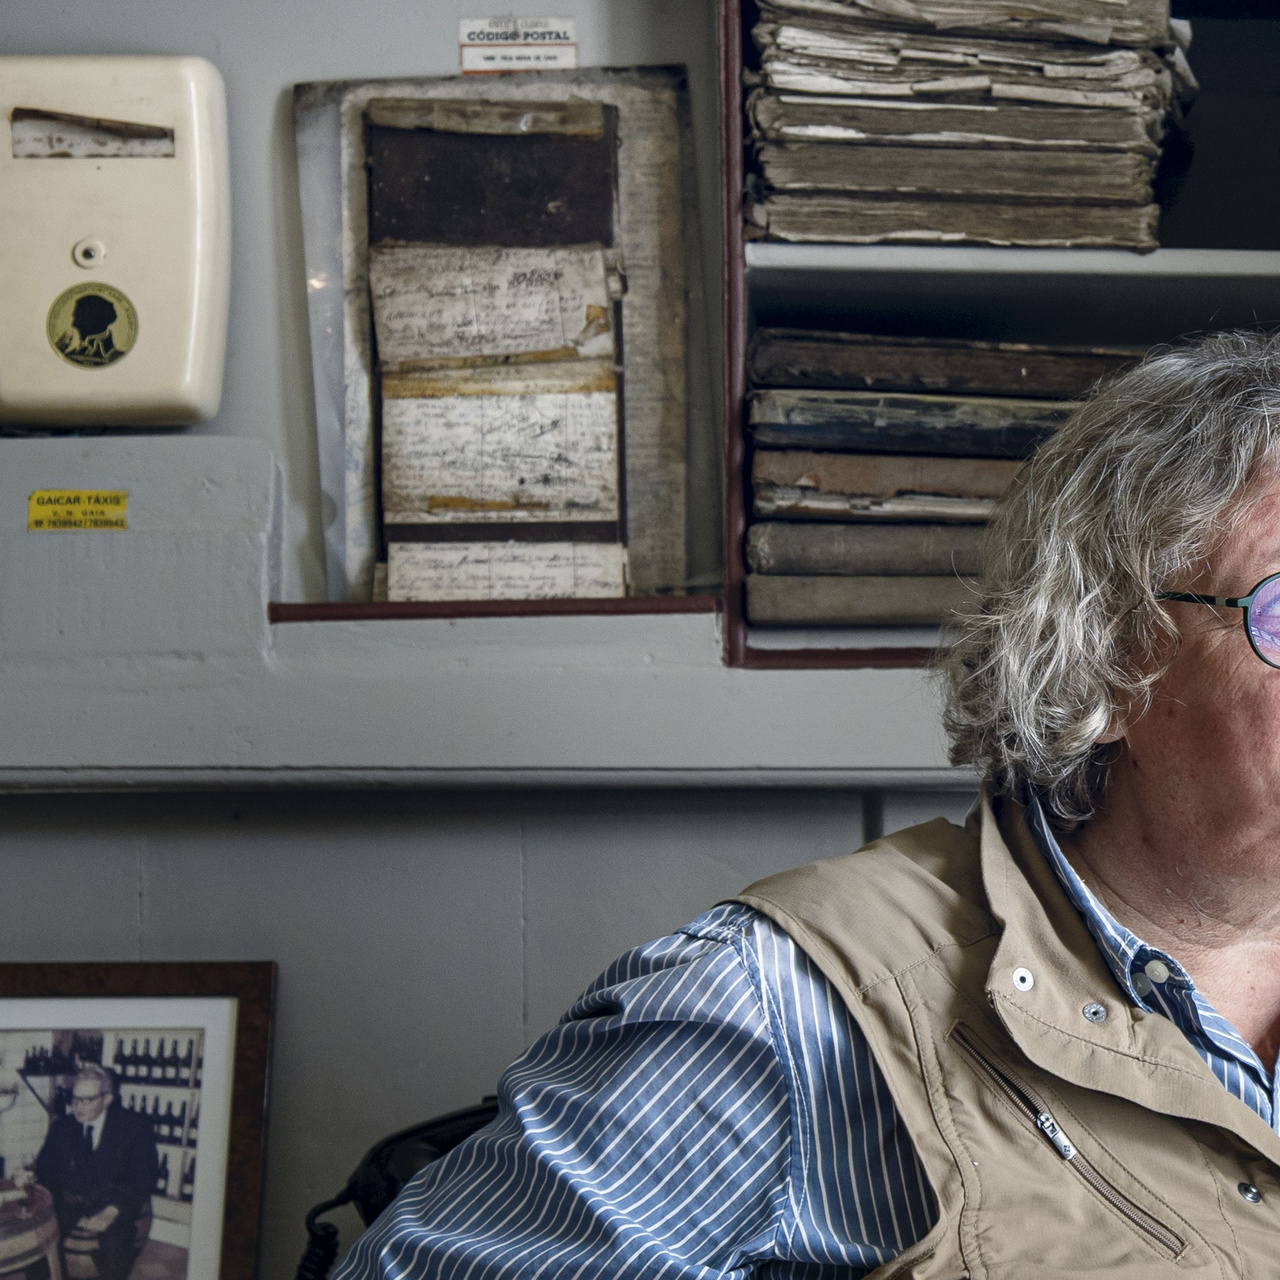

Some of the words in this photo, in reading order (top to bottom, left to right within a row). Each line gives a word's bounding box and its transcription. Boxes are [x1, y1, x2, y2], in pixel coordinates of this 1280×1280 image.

[467, 29, 520, 41] CÓDIGO
[523, 31, 570, 41] POSTAL
[36, 496, 80, 506] GAICAR
